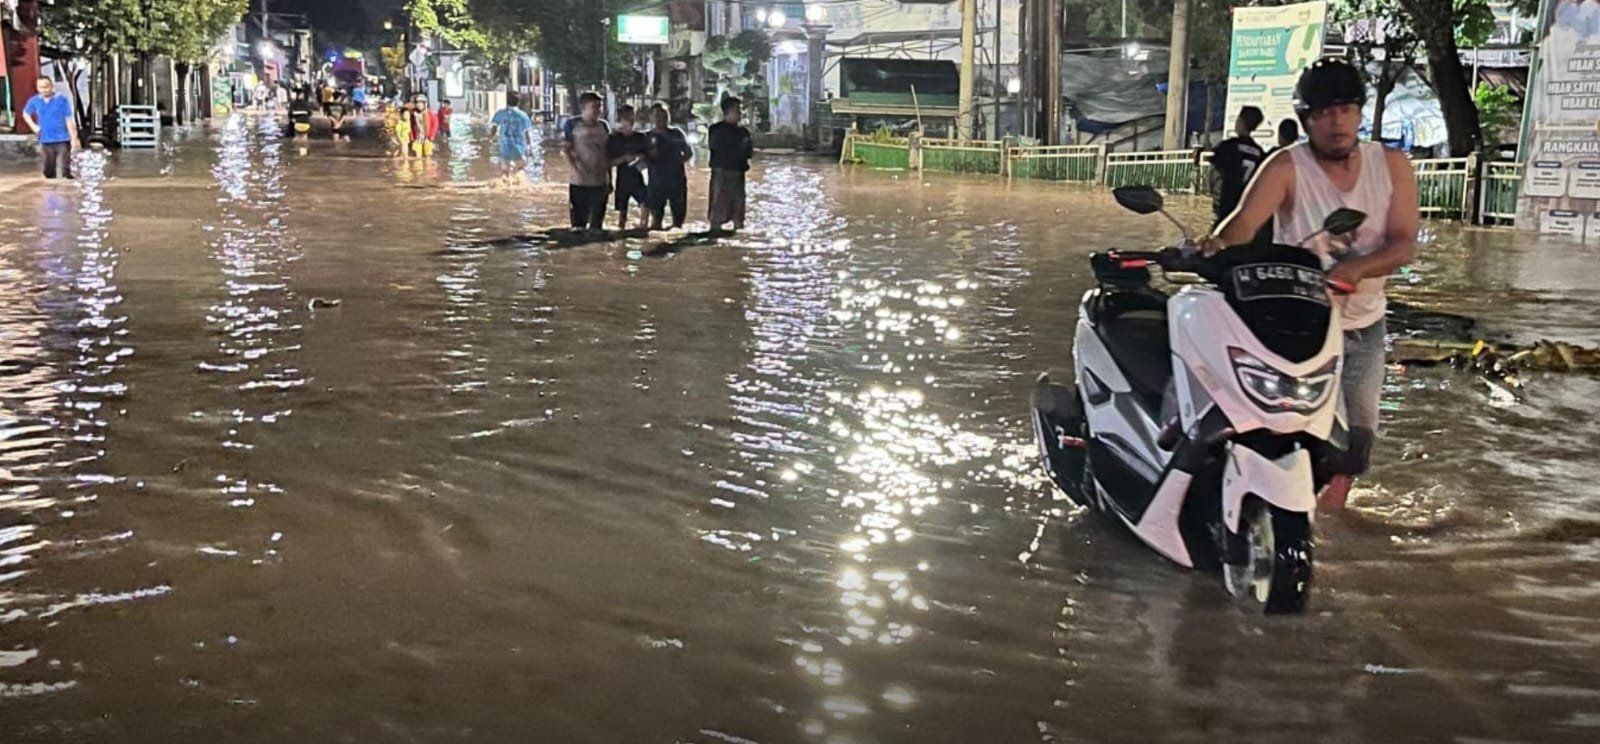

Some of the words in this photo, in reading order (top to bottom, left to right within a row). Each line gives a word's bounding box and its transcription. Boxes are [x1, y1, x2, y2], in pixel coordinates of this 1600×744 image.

[1569, 59, 1594, 71] MBAH
[1548, 82, 1572, 93] MBAH
[1562, 97, 1587, 109] MBAH
[1242, 159, 1256, 182] 7
[1238, 268, 1251, 281] W
